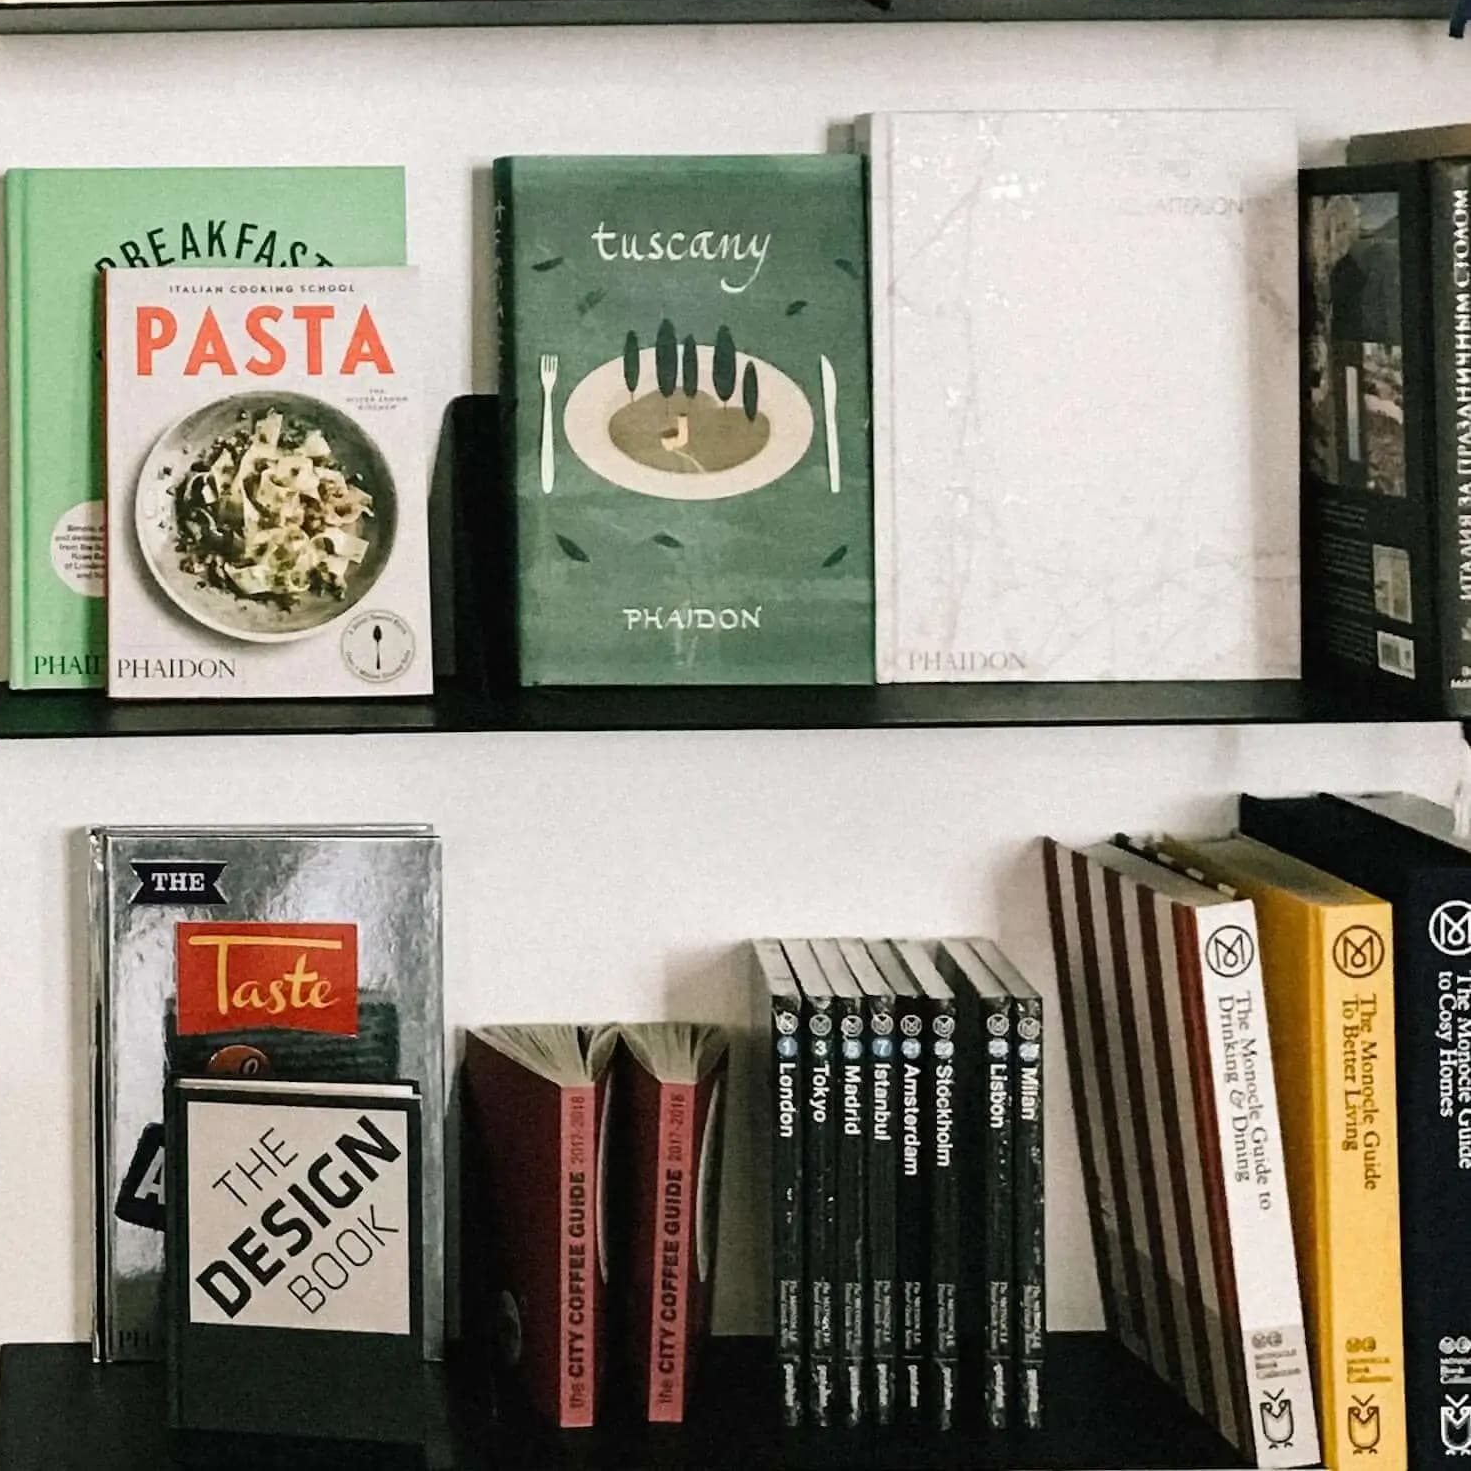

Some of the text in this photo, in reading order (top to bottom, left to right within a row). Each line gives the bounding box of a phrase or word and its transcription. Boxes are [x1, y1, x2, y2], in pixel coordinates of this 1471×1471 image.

[169, 283, 355, 294] ITALIAN COOKING SCHOOL
[590, 220, 772, 294] tuscany
[135, 304, 396, 377] PASTA
[622, 605, 763, 630] PHAIDON
[115, 657, 237, 679] PHAIDON
[907, 650, 1028, 671] PHAIDON
[151, 872, 206, 892] THE
[186, 934, 344, 1017] Taste
[1456, 968, 1471, 1012] The
[809, 1040, 830, 1123] 3 Tokyo
[1341, 994, 1362, 1152] To Better Living
[1435, 970, 1458, 1119] to Cosy Homes
[1457, 1017, 1471, 1104] Monocle
[779, 1062, 796, 1138] London
[844, 1064, 862, 1136] Madrid
[873, 1062, 892, 1142] Istanbul
[903, 1062, 922, 1177] Amsterdam
[935, 1064, 954, 1168] Stockholm
[989, 1063, 1008, 1129] Lisbon
[1020, 1066, 1039, 1121] Milan
[1218, 995, 1250, 1183] Drinking & Dining
[1235, 990, 1273, 1211] The Monocle Guide to
[1360, 992, 1382, 1191] The Monocle Guide
[211, 1127, 298, 1207] THE
[663, 1168, 683, 1236] GUIDE
[195, 1114, 402, 1320] DESIGN
[569, 1171, 586, 1239] GUIDE
[286, 1202, 400, 1315] BOOK
[568, 1242, 586, 1325] COFFEE
[660, 1239, 680, 1323] COFFEE
[568, 1331, 585, 1379] CITY
[657, 1326, 676, 1375] CITY
[570, 1383, 585, 1409] the
[659, 1380, 674, 1405] the
